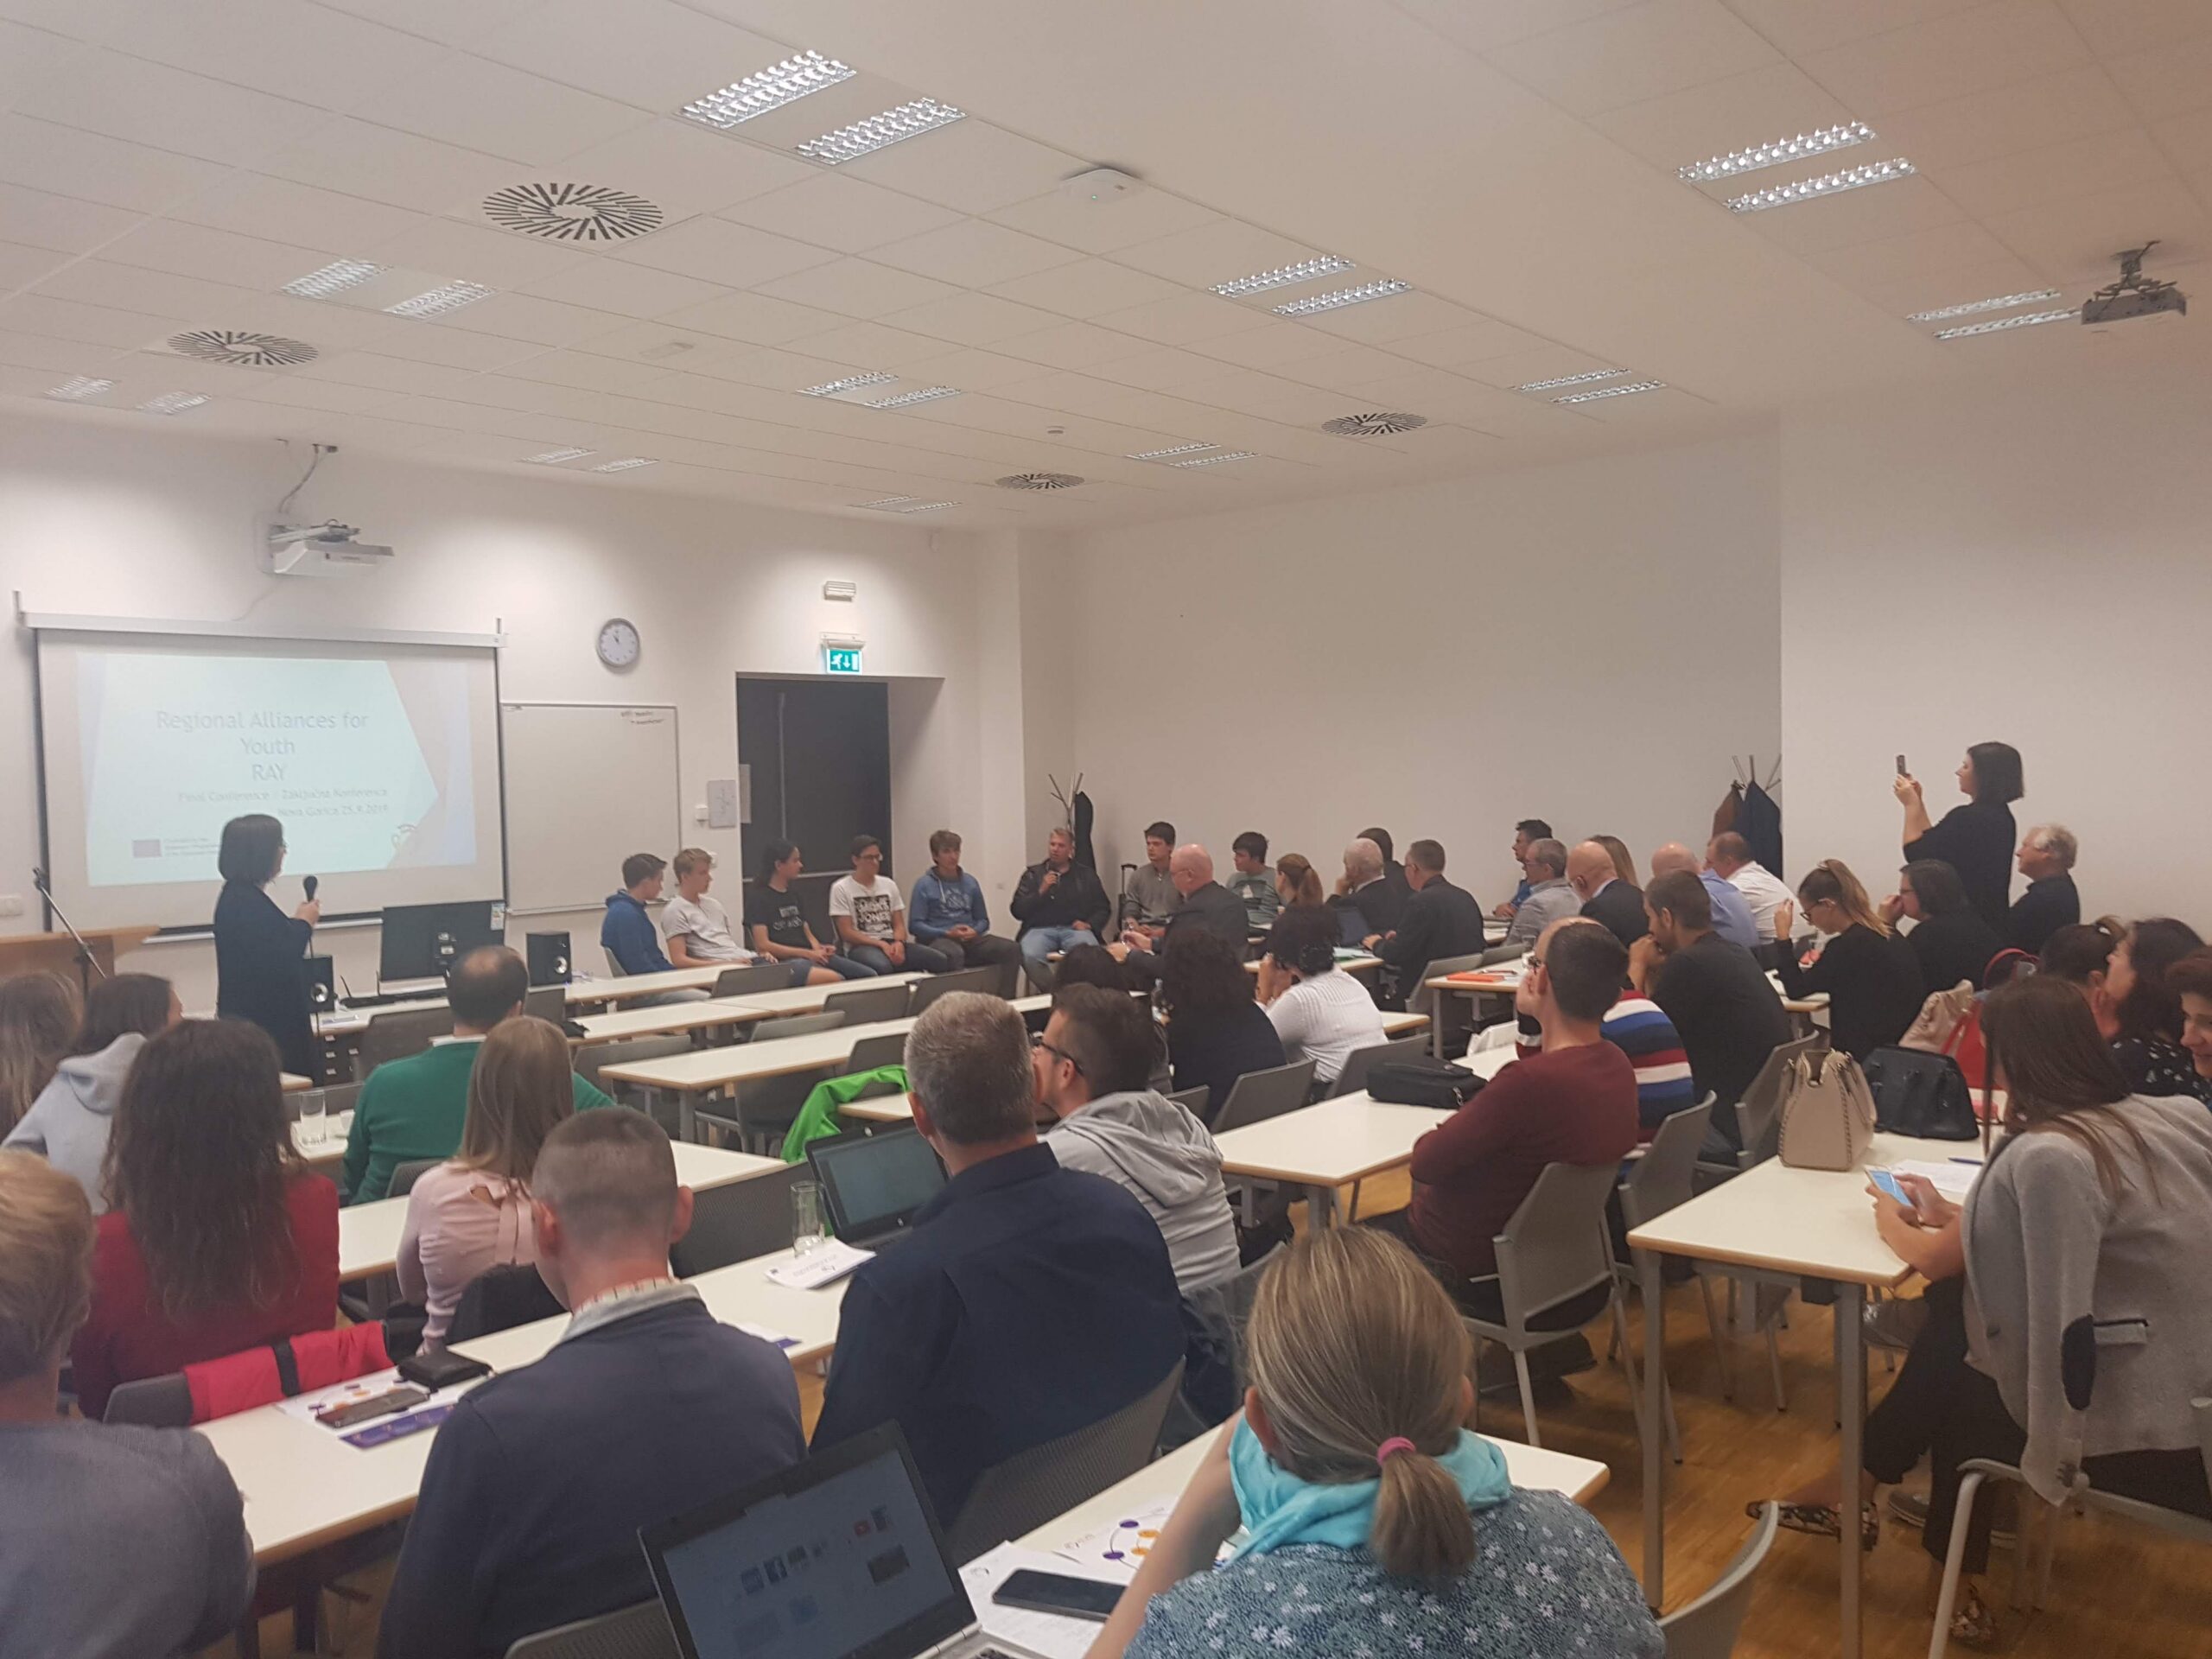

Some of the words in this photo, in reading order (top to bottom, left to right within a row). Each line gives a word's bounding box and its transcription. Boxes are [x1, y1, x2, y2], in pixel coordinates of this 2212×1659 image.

[156, 710, 245, 733] Regional
[249, 711, 337, 729] Alliances
[342, 711, 369, 729] for
[239, 737, 296, 755] Youth
[251, 763, 288, 782] RAY
